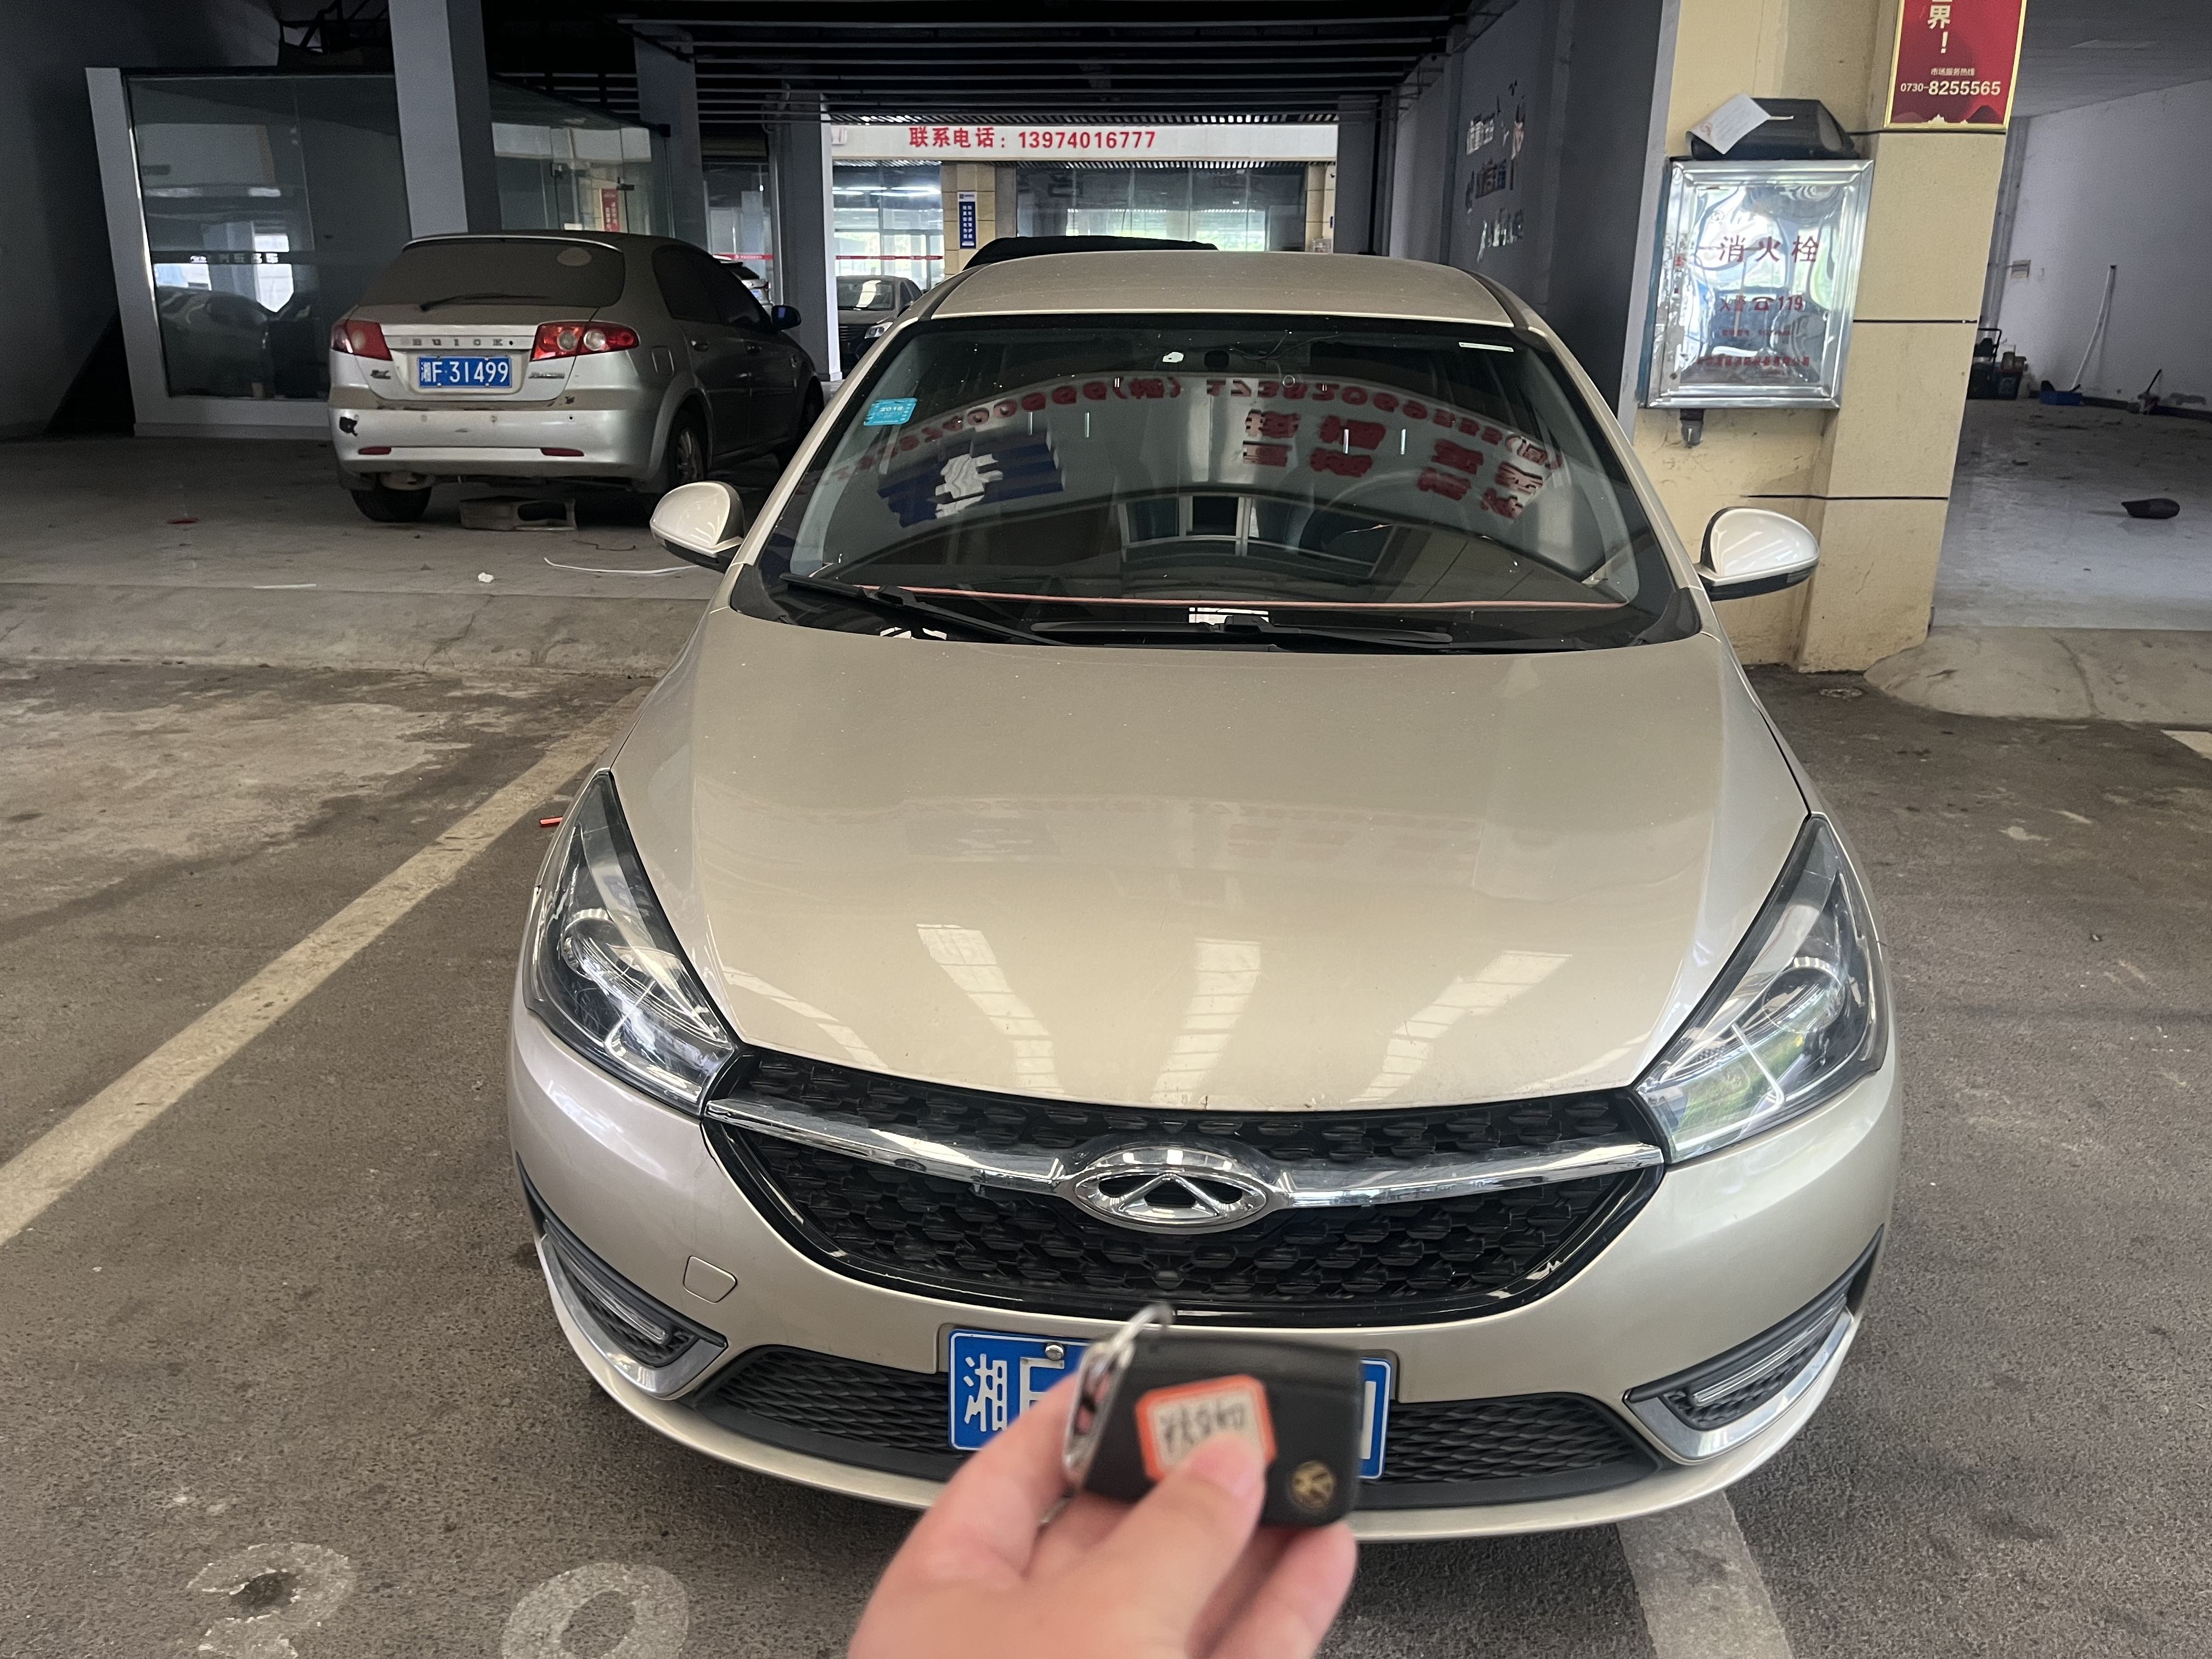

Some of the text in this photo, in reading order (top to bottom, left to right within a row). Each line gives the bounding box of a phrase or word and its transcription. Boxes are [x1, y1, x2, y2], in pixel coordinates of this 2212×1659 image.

[1927, 0, 1953, 54] 界！
[1900, 81, 2001, 95] 0730-8255565
[1719, 235, 1819, 263] 消火栓
[1778, 295, 1804, 311] 119
